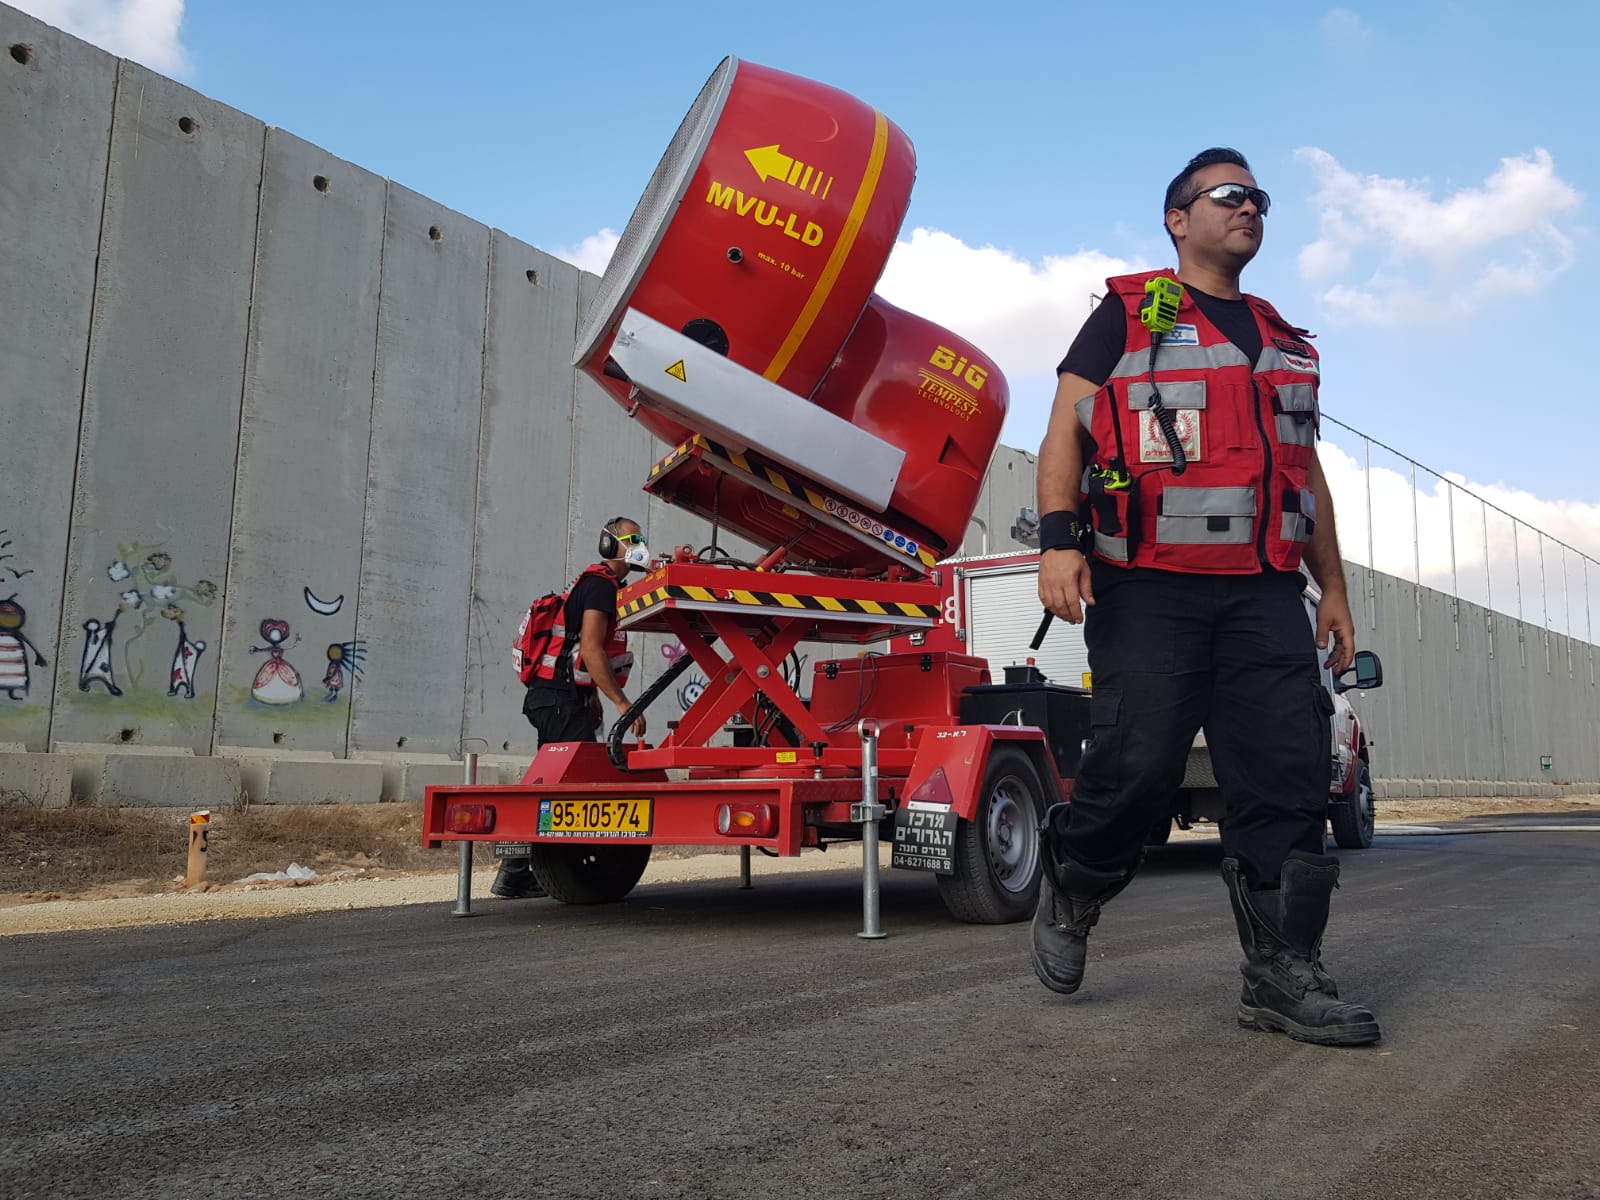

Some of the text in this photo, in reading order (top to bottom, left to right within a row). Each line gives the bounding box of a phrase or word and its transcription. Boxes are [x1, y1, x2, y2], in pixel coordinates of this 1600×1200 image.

[705, 181, 824, 247] MVU-LD
[757, 252, 805, 280] max. 10 bar
[917, 388, 971, 422] TECHNOLOGY
[919, 376, 978, 416] TEMPEST
[909, 811, 945, 828] מרכז
[895, 826, 953, 846] הגרורים
[899, 844, 947, 857] פרדס חנה
